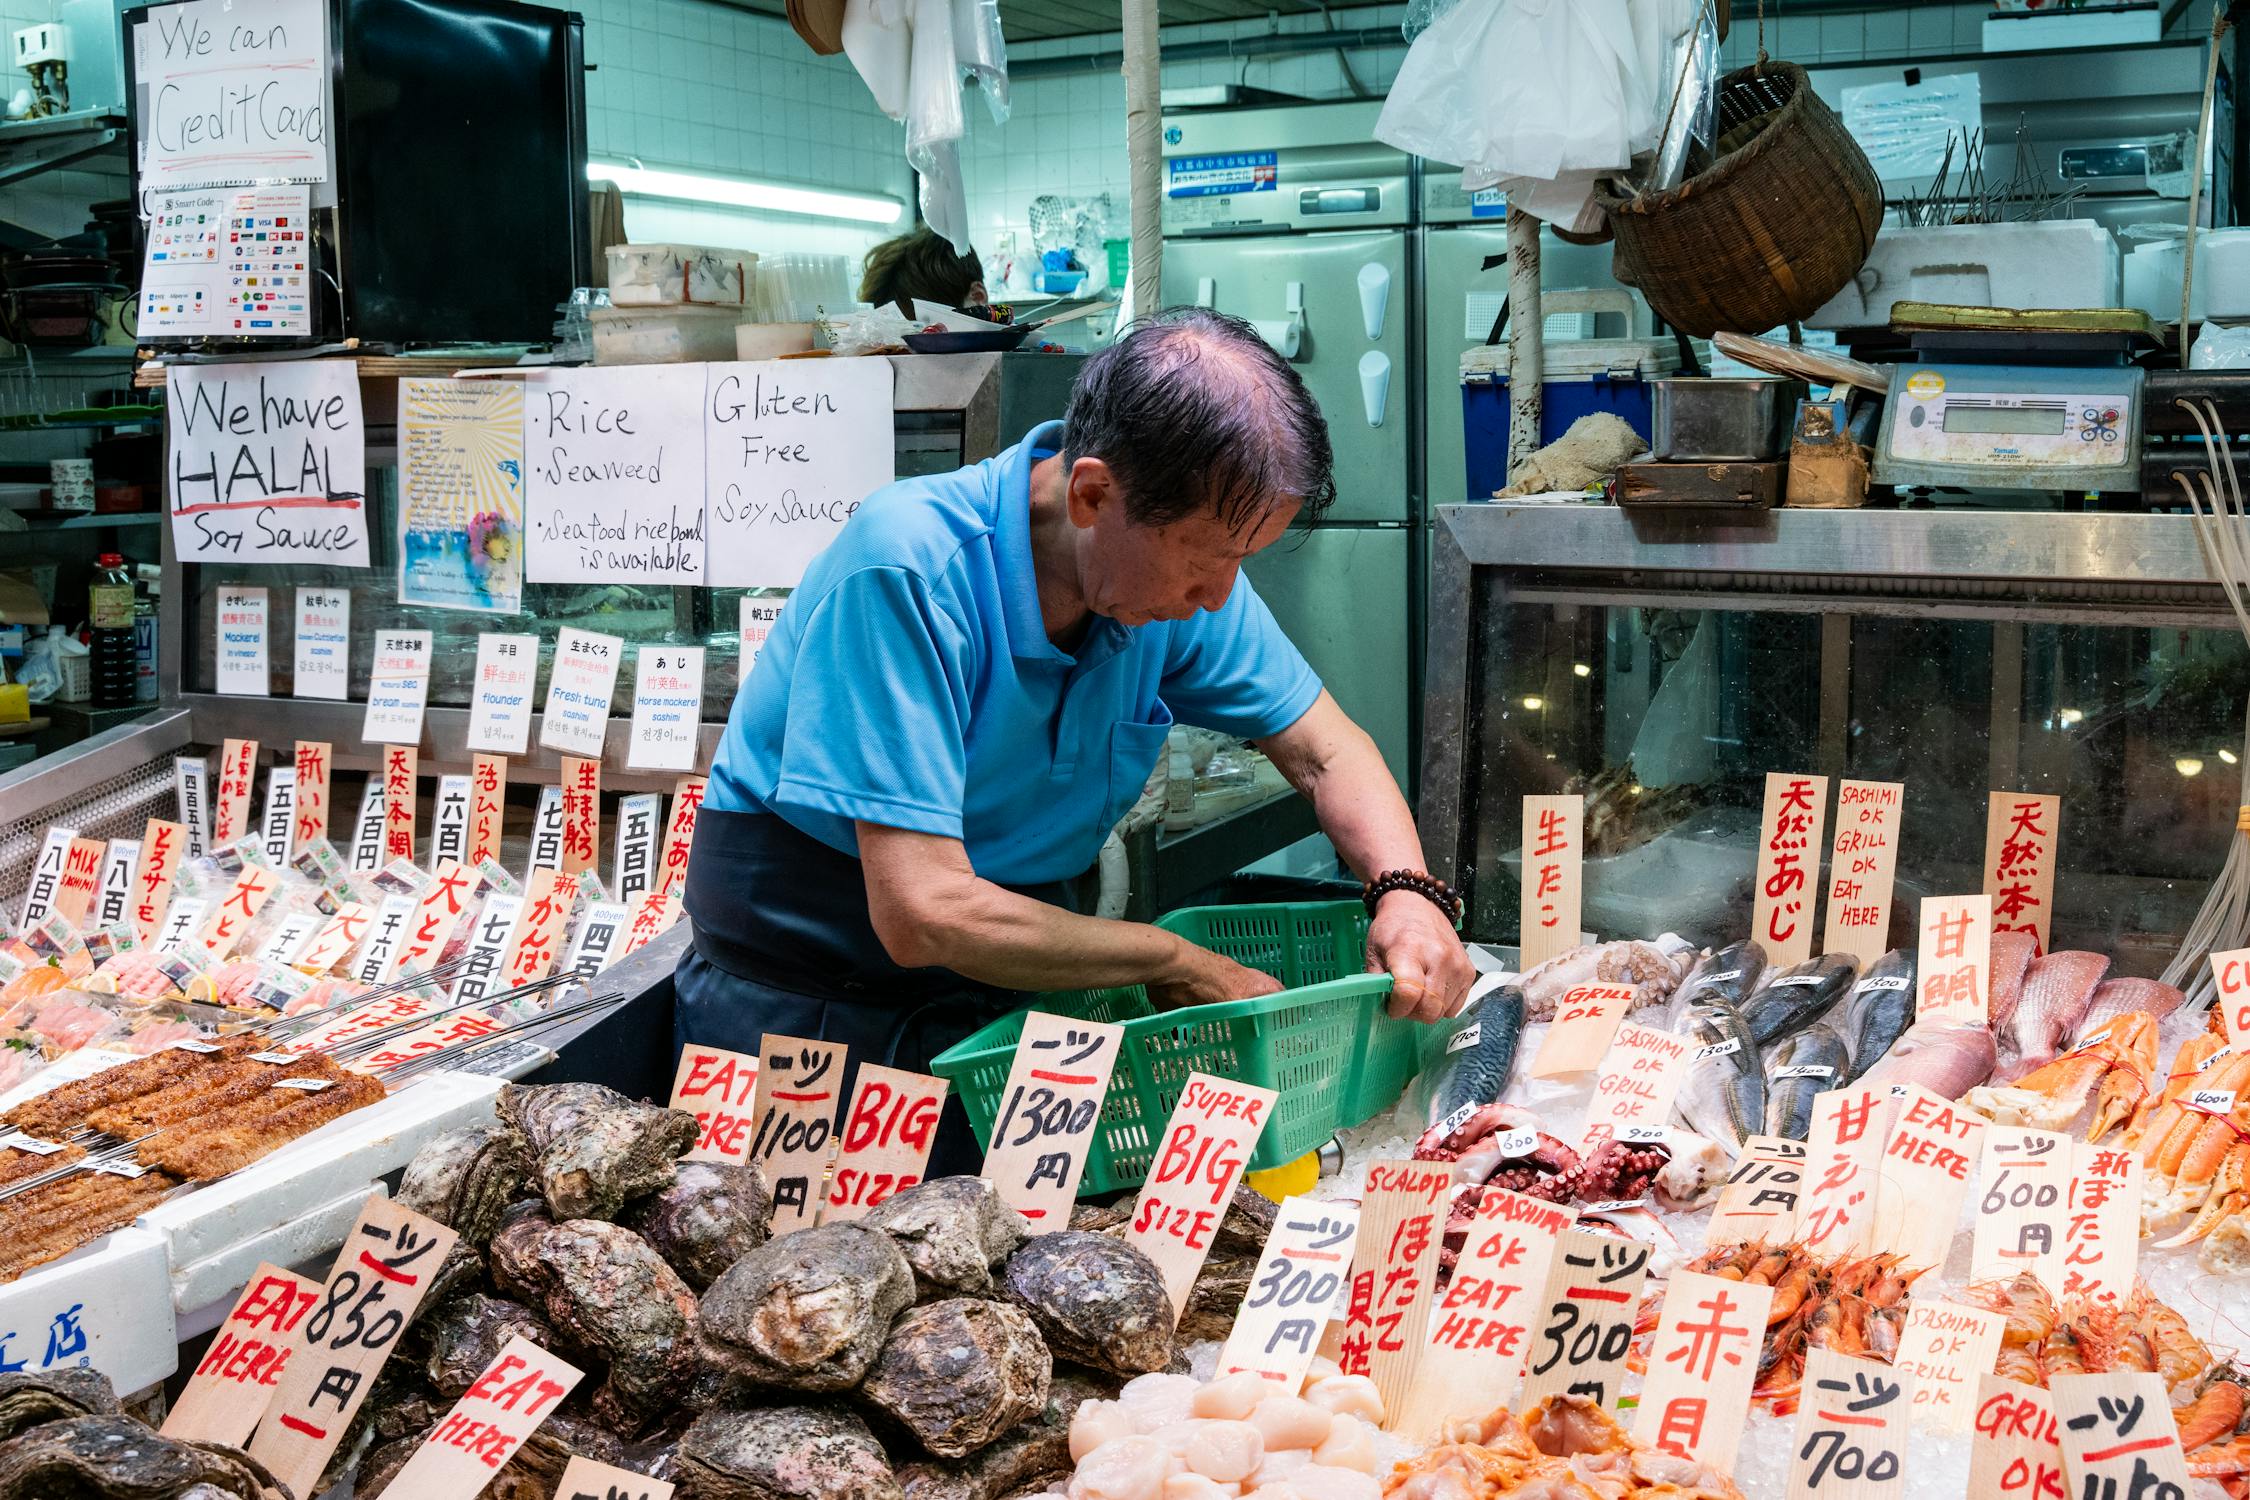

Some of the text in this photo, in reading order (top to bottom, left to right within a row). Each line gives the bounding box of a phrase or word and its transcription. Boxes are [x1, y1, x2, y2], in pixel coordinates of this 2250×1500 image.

[158, 16, 212, 59] We
[230, 25, 287, 51] can
[175, 376, 349, 436] We have
[548, 390, 635, 438] Rice
[713, 375, 838, 423] Gluten
[545, 446, 663, 485] Seaweed
[742, 436, 810, 468] Free
[177, 437, 365, 511] HALAL
[714, 484, 860, 528] Soy Sauce
[194, 506, 358, 553] Soy Sauce
[635, 517, 669, 541] rice
[580, 546, 603, 570] is
[224, 632, 260, 643] Mackerel
[385, 639, 422, 652] 天然本鯛
[498, 644, 517, 656] 平目
[570, 639, 609, 657] 生まぐろ
[372, 697, 400, 707] bream
[482, 692, 523, 706] flounder
[553, 687, 607, 709] Fresh tuna
[562, 709, 590, 722] sashimi
[637, 697, 698, 708] Horse mackerel
[652, 712, 681, 722] sashimi
[642, 728, 673, 742] 전갱이
[296, 746, 324, 841] 新いか
[1840, 786, 1898, 806] SASHIMI
[184, 774, 202, 857] 四百五十円
[267, 784, 294, 866] 五百円
[356, 787, 385, 870] 六百円
[1859, 809, 1883, 825] OK
[533, 801, 562, 871] 七百
[1835, 829, 1887, 852] GRILL
[67, 846, 99, 874] MIX
[622, 811, 650, 902] 五百円
[1534, 809, 1569, 928] 生たこ
[1765, 780, 1815, 942] 天然あじ
[1852, 859, 1877, 874] OK
[24, 846, 61, 928] 八百円
[60, 873, 93, 892] SASHIMI
[101, 860, 129, 928] 八百
[1834, 879, 1862, 900] EAT
[1993, 802, 2047, 959] 天然本
[593, 908, 625, 922] 400yen
[1840, 904, 1879, 927] HERE
[361, 914, 402, 986] 千六百
[1919, 909, 1980, 1013] 甘鯛
[1563, 988, 1632, 1003] GRILL
[1862, 979, 1899, 990] 1500
[1563, 1006, 1604, 1022] OK
[1031, 1030, 1106, 1066] 一ツ
[1614, 1028, 1685, 1060] SASHIMI
[1696, 1043, 1733, 1059] 1300
[679, 1055, 758, 1105] EAT
[769, 1048, 832, 1088] 一ツ
[1633, 1059, 1663, 1072] OK
[1182, 1082, 1264, 1127] SUPER
[1599, 1074, 1656, 1099] GRILL
[2195, 1092, 2228, 1105] 4000
[843, 1082, 938, 1154] BIG
[993, 1085, 1096, 1150] 1300
[1446, 1108, 1470, 1133] 850
[1612, 1102, 1642, 1118] OK
[1903, 1097, 1985, 1140] EAT
[694, 1111, 752, 1156] ERE
[750, 1105, 830, 1160] 1100
[1584, 1124, 1613, 1145] EA
[1628, 1128, 1663, 1139] 900
[1994, 1135, 2056, 1156] 一ツ
[1025, 1152, 1071, 1190] 円
[1155, 1123, 1242, 1205] BIG
[1808, 1093, 1881, 1246] 甘えび
[1888, 1132, 1969, 1181] HERE
[772, 1176, 808, 1218] 円
[1366, 1166, 1449, 1205] SCALOP
[1749, 1190, 1798, 1211] 円
[1980, 1170, 2058, 1215] 600
[1134, 1198, 1215, 1250] SIZE
[1477, 1191, 1571, 1234] SASHIMI
[361, 1223, 437, 1268] 一ツ
[1286, 1216, 1354, 1249] 一ツ
[1477, 1234, 1527, 1268] OK
[2018, 1224, 2052, 1255] 円
[1376, 1214, 1434, 1352] ほたて
[1565, 1244, 1649, 1283] 一ツ
[1248, 1258, 1340, 1309] 300
[1440, 1275, 1522, 1311] EAT
[234, 1275, 319, 1332] EAT
[305, 1270, 404, 1351] 850
[1908, 1306, 1987, 1338] SASHIMI
[1265, 1319, 1316, 1355] 円
[1433, 1311, 1526, 1357] HERE
[1532, 1302, 1632, 1376] 300
[1929, 1337, 1966, 1356] OK
[197, 1333, 292, 1386] HERE
[1658, 1290, 1749, 1461] 赤貝
[309, 1366, 362, 1413] 円
[463, 1354, 565, 1417] EAT
[1816, 1372, 1900, 1411] 一ツ
[1912, 1389, 1952, 1407] OK
[2067, 1394, 2144, 1437] 一ツ
[430, 1412, 518, 1468] HERE
[1800, 1430, 1899, 1489] 700
[2000, 1457, 2064, 1500] OK
